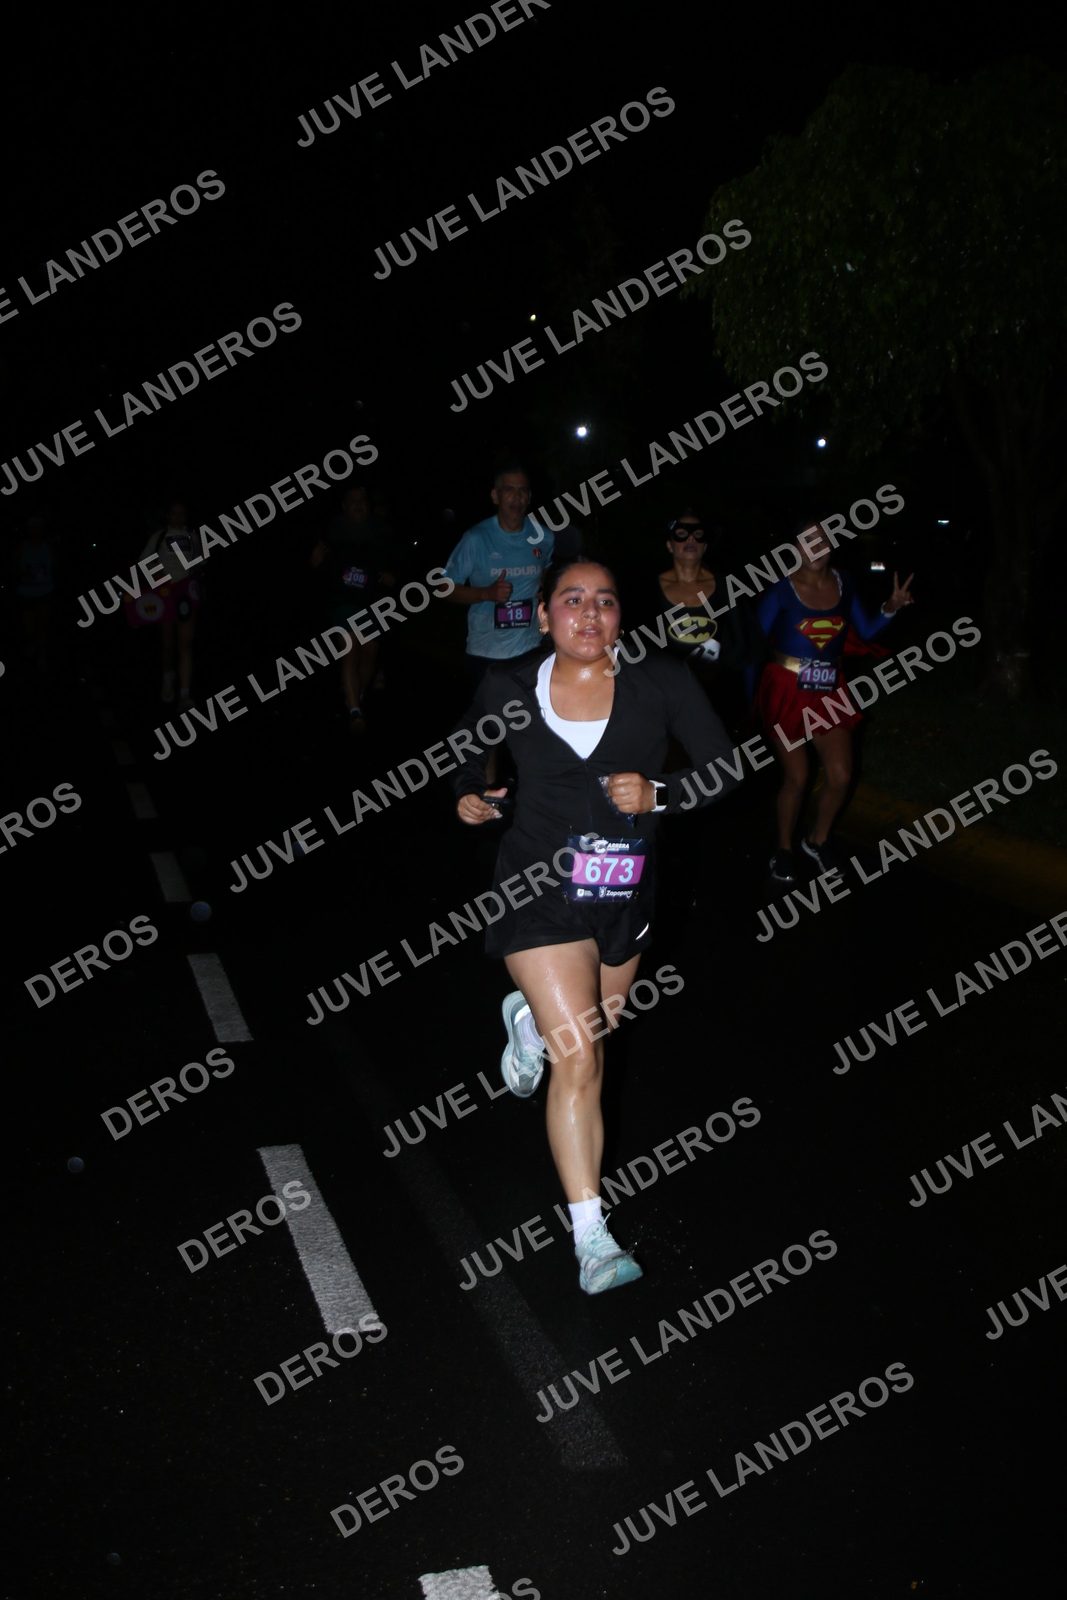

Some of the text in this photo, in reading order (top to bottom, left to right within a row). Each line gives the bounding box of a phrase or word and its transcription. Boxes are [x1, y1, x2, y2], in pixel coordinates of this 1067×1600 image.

[507, 608, 523, 620] 18
[804, 668, 836, 682] 1904
[585, 857, 634, 883] 673
